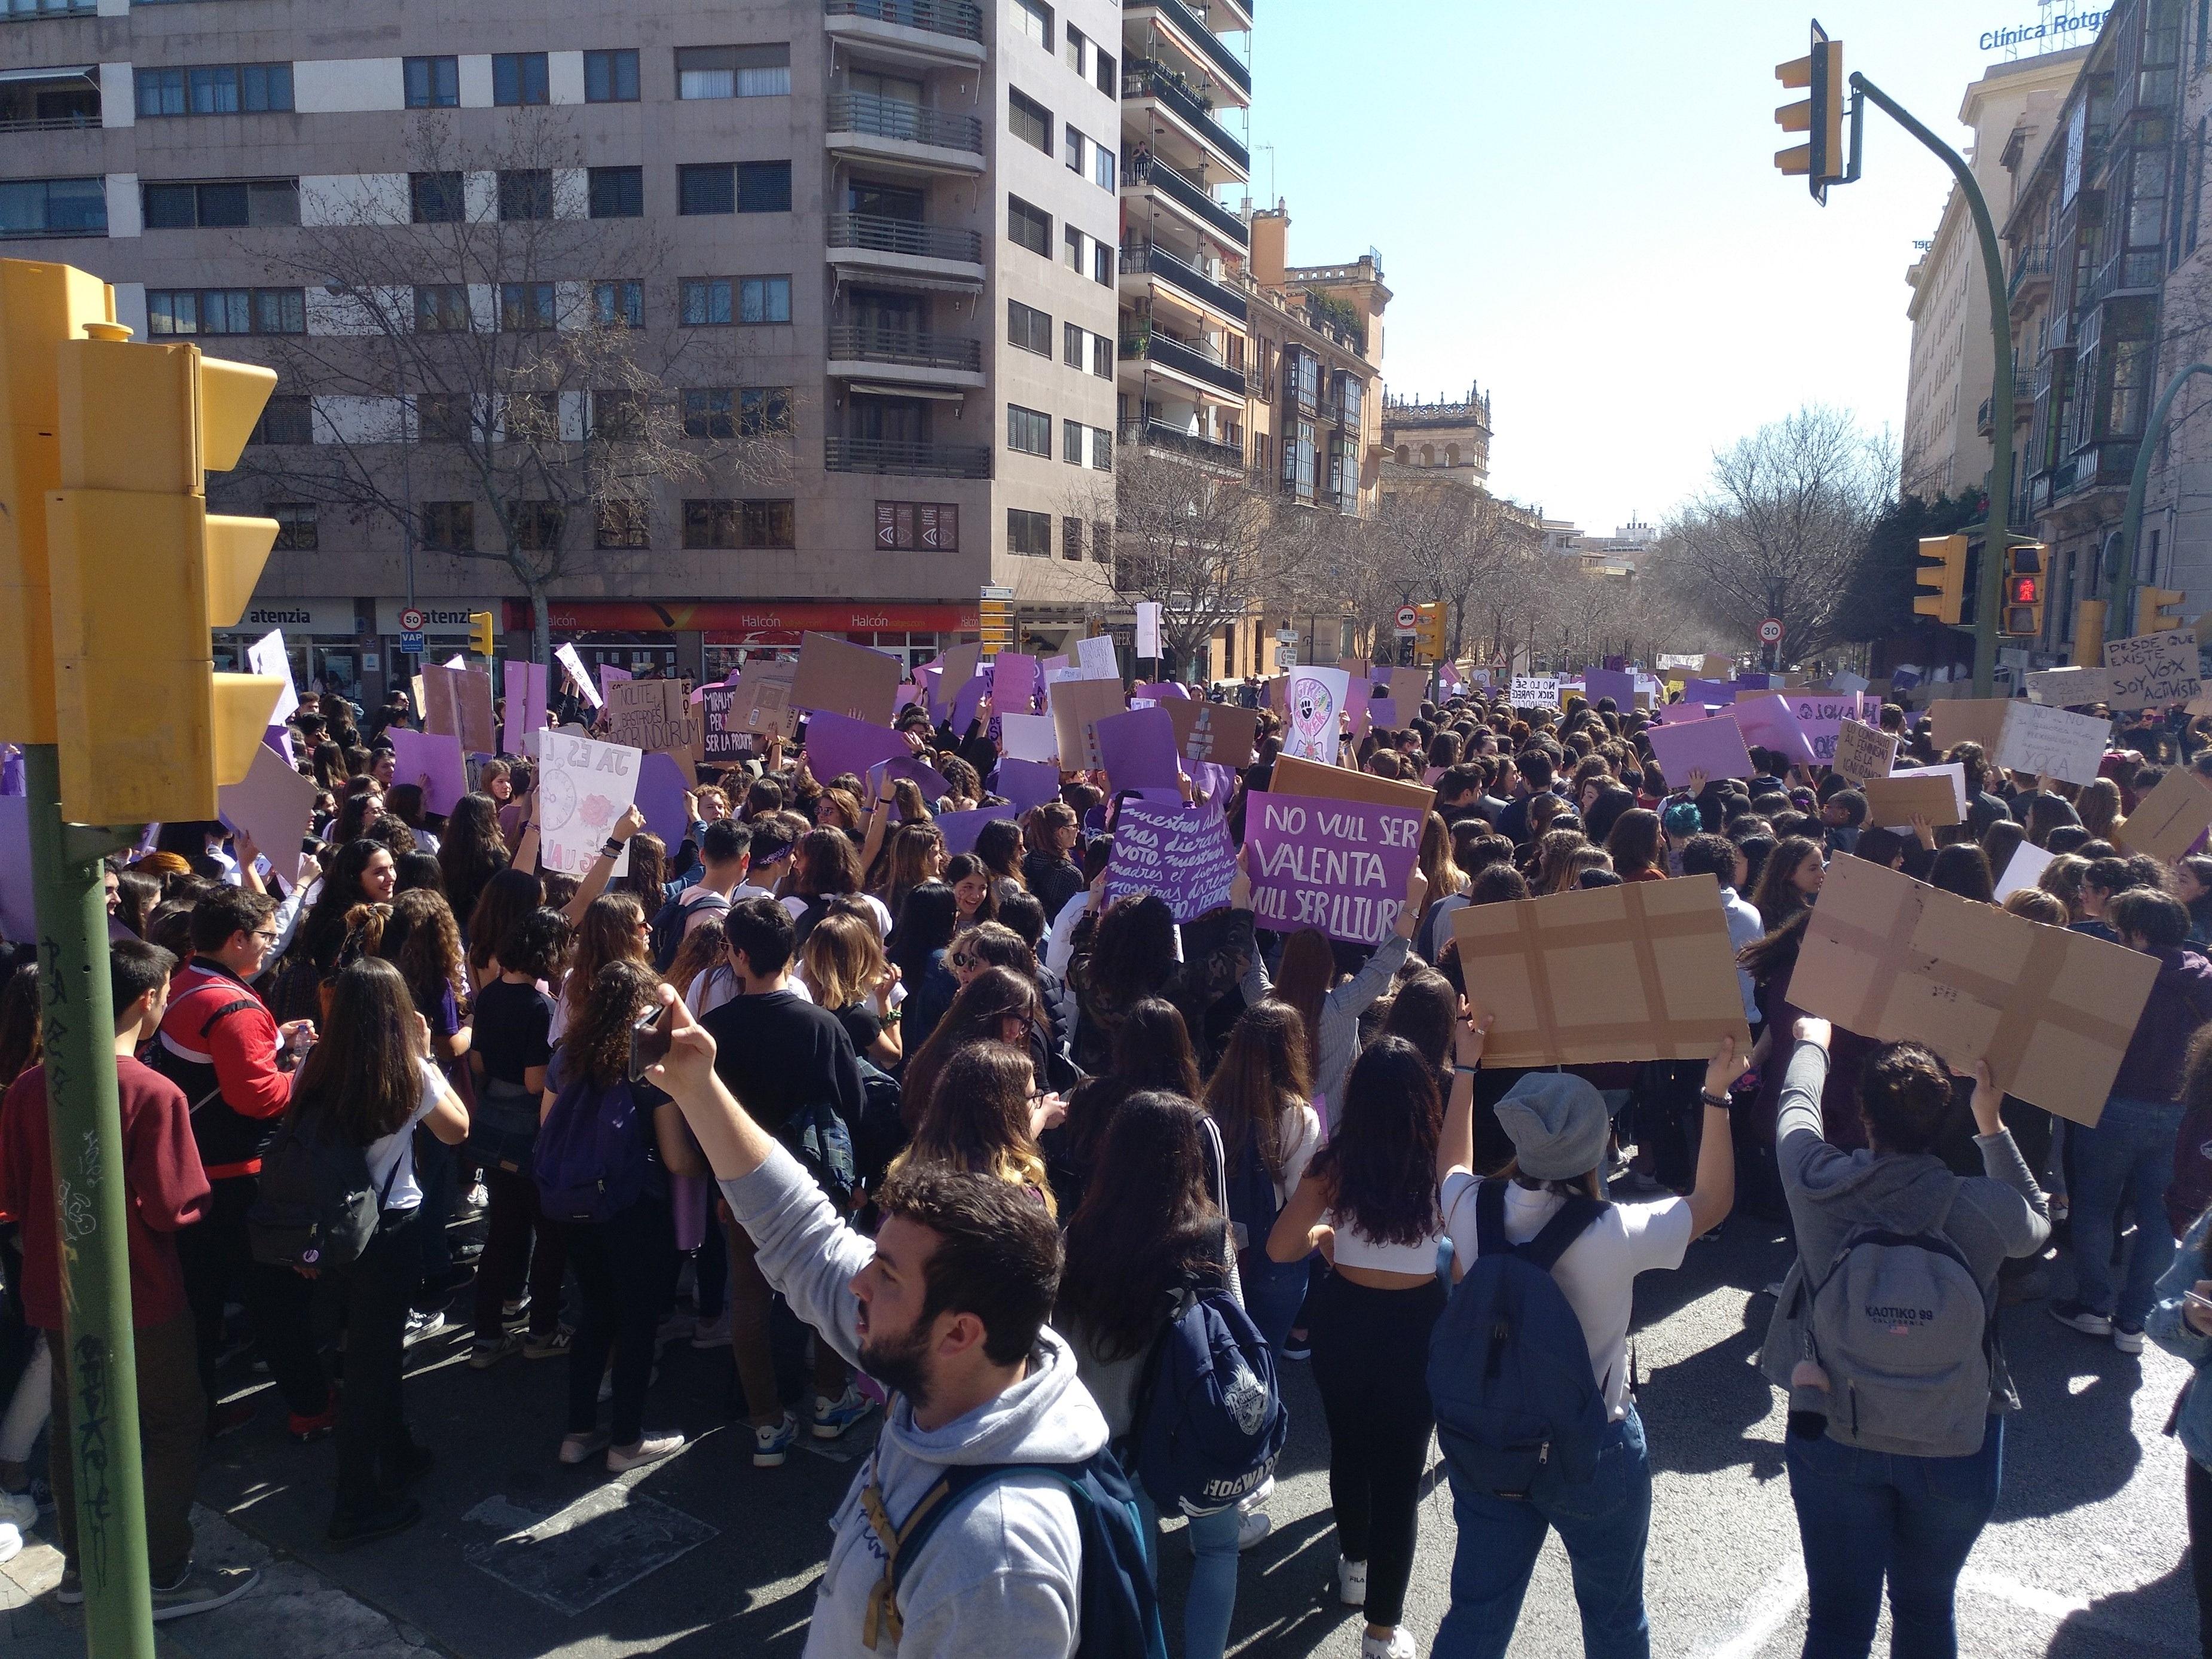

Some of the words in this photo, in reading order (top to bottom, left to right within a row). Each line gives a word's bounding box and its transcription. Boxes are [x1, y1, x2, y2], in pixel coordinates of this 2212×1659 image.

[1980, 25, 2046, 50] Clínica
[2054, 8, 2113, 34] Rotge
[250, 608, 310, 624] atenzia
[406, 616, 419, 624] 50
[423, 608, 478, 624] atenzi
[548, 612, 577, 626] alcón
[742, 612, 781, 627] Halcón
[852, 612, 888, 627] Halcón
[1099, 631, 1131, 646] NIFER
[1764, 627, 1779, 636] 30
[2109, 637, 2160, 653] DESDE
[2167, 634, 2196, 646] QUE
[2112, 649, 2165, 667] EXISTE
[2145, 658, 2186, 680] VOX
[621, 683, 655, 706] NOLITE
[2113, 675, 2146, 695] SOY
[2144, 678, 2202, 701] ACTIVISTA
[622, 708, 662, 728] BASTARDES
[2034, 708, 2048, 718] NO
[2066, 714, 2084, 726] NO
[705, 734, 719, 752] SER
[720, 734, 731, 751] LA
[1844, 734, 1854, 747] AL
[1847, 722, 1855, 734] LO
[1858, 726, 1890, 748] CONTRARIO
[1854, 750, 1862, 761] ES
[1863, 754, 1872, 766] LA
[2021, 750, 2069, 780] YOGA
[1120, 807, 1200, 834] nuestras
[1265, 804, 1306, 835] NO
[1317, 811, 1368, 842] VULL
[1379, 815, 1419, 848] SER
[1118, 824, 1159, 848] nos
[1116, 841, 1162, 867] VOTO,
[1165, 845, 1225, 868] nuestras
[1255, 839, 1387, 888] VALENTA
[1109, 861, 1163, 882] madres
[1171, 869, 1186, 883] el
[1107, 881, 1181, 902] nosotras
[1292, 889, 1330, 926] SER
[1865, 1305, 1916, 1319] KAOTIKO
[1203, 1447, 1282, 1496] HOGWAR
